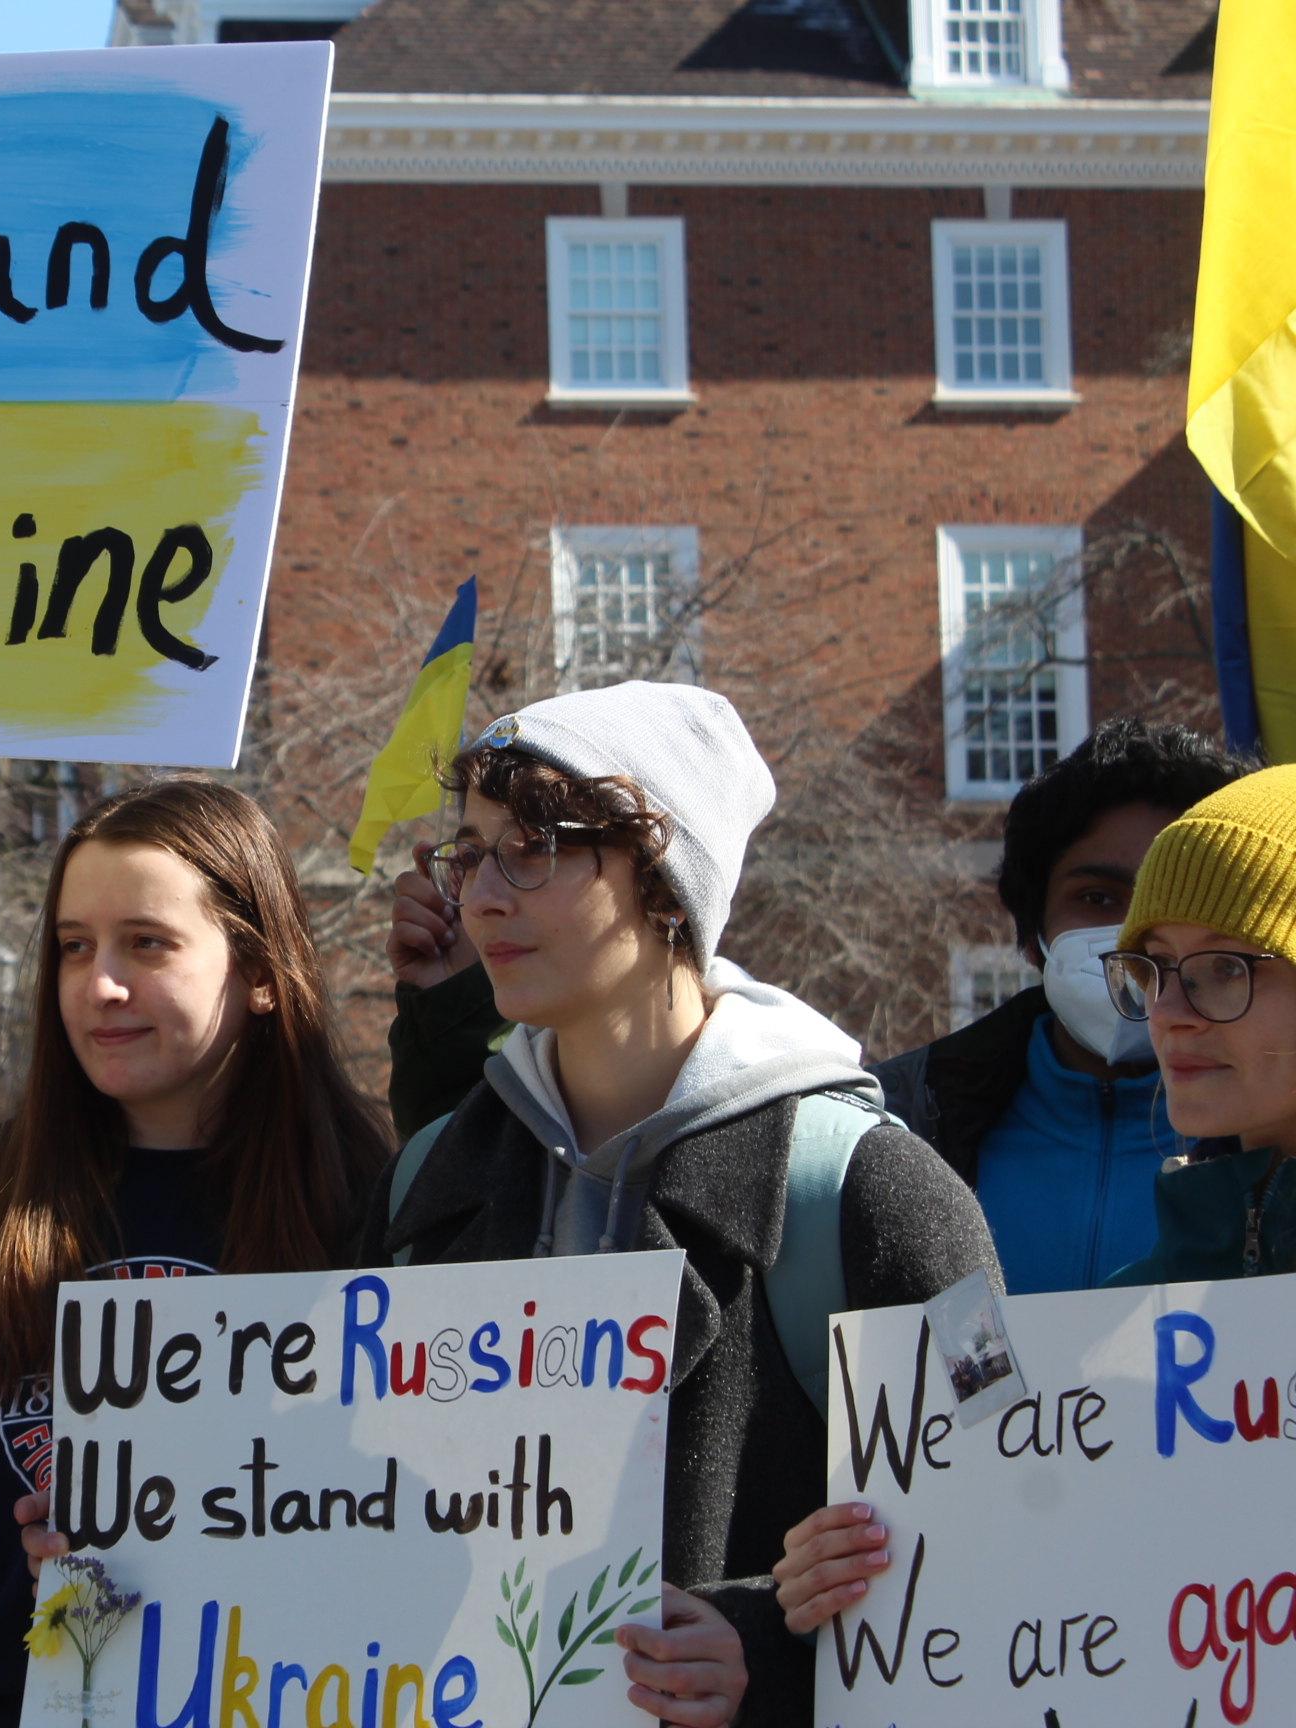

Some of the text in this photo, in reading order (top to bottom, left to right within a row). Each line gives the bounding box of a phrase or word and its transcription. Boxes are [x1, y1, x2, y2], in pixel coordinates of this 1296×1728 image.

[61, 1298, 317, 1416] We're
[832, 1315, 952, 1494] We
[997, 1385, 1114, 1462] are
[54, 1434, 574, 1551] We stand with
[136, 1600, 483, 1728] Ukraine
[832, 1533, 963, 1692] We
[1009, 1613, 1127, 1689] are
